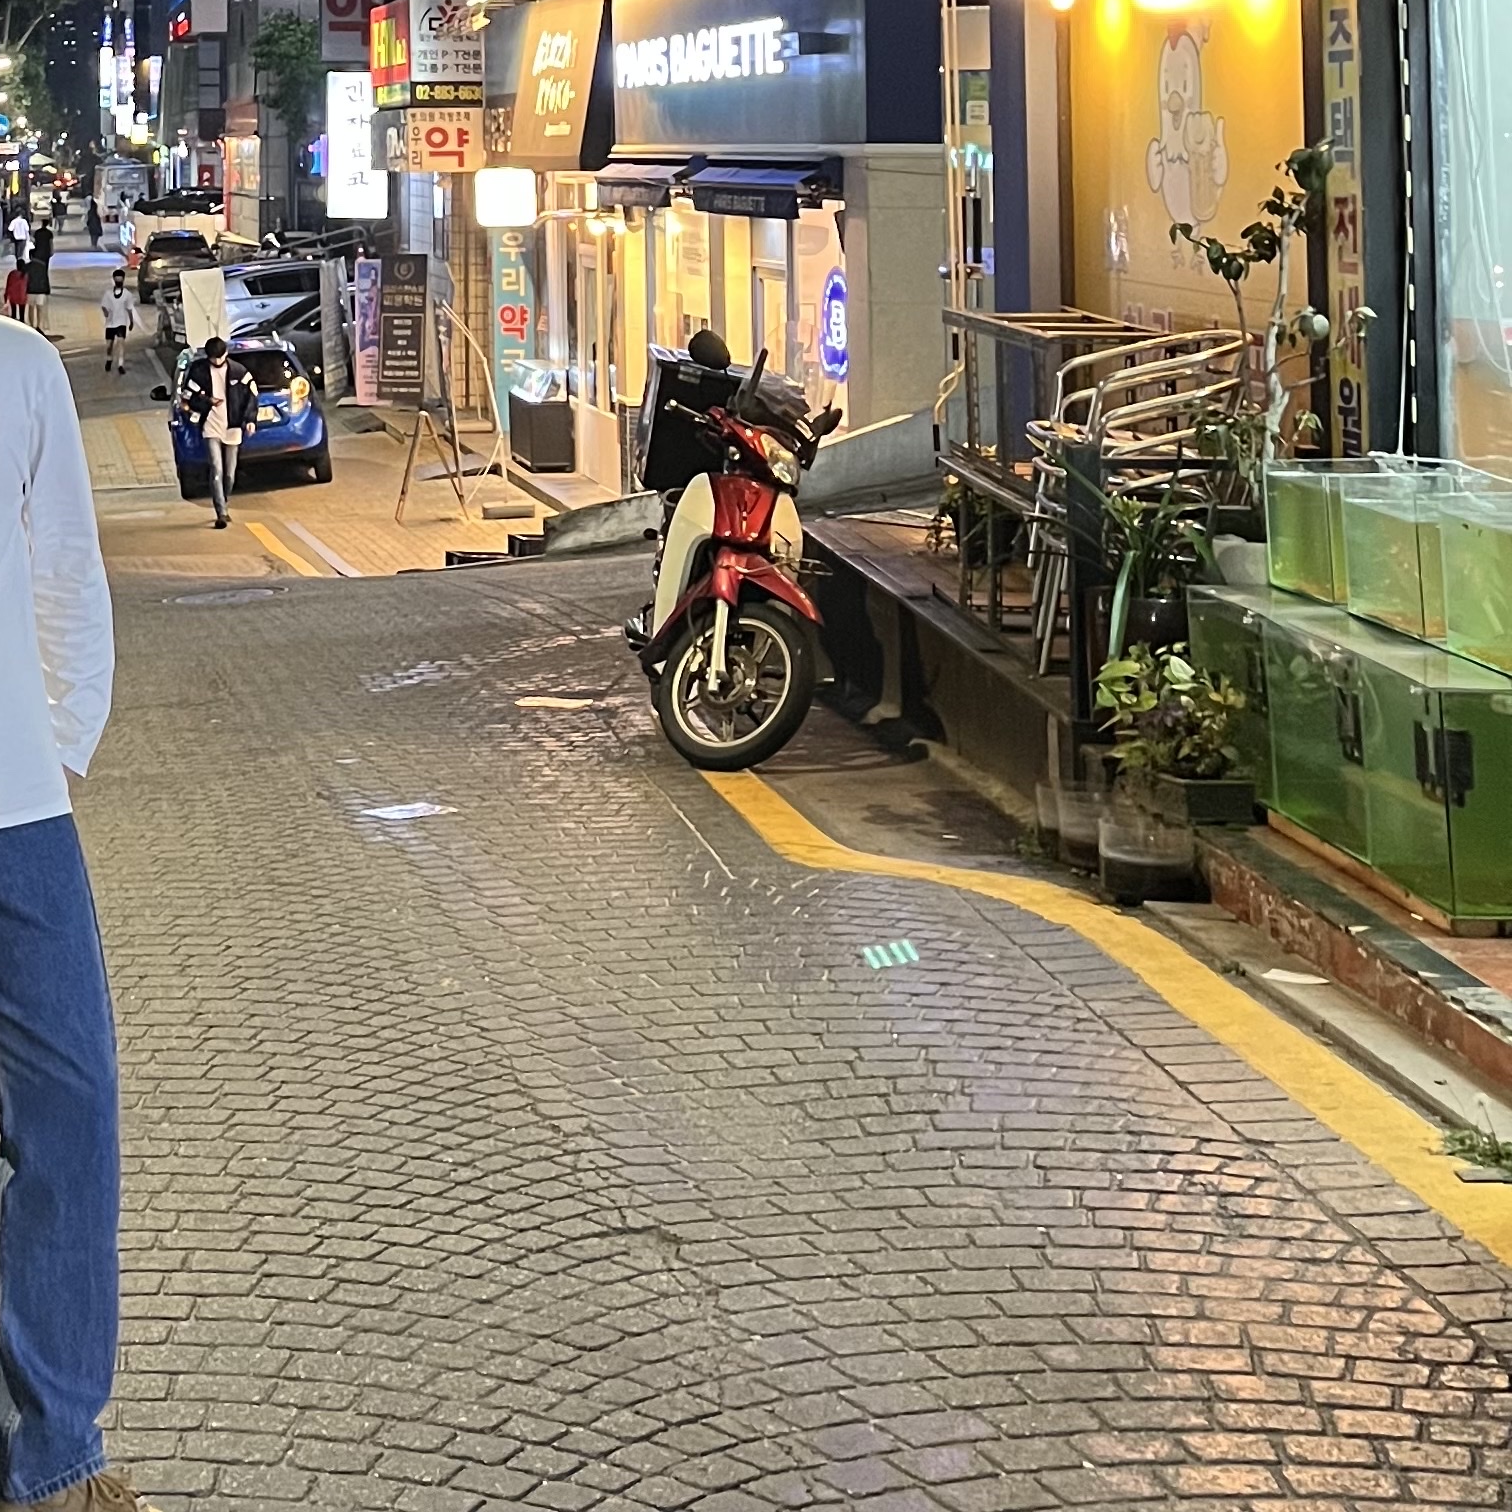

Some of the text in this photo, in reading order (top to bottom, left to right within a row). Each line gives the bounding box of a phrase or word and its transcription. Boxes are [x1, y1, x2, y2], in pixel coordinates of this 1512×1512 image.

[615, 16, 785, 89] PARIS BAGUETTE
[410, 126, 423, 170] 우리
[424, 126, 470, 169] 약
